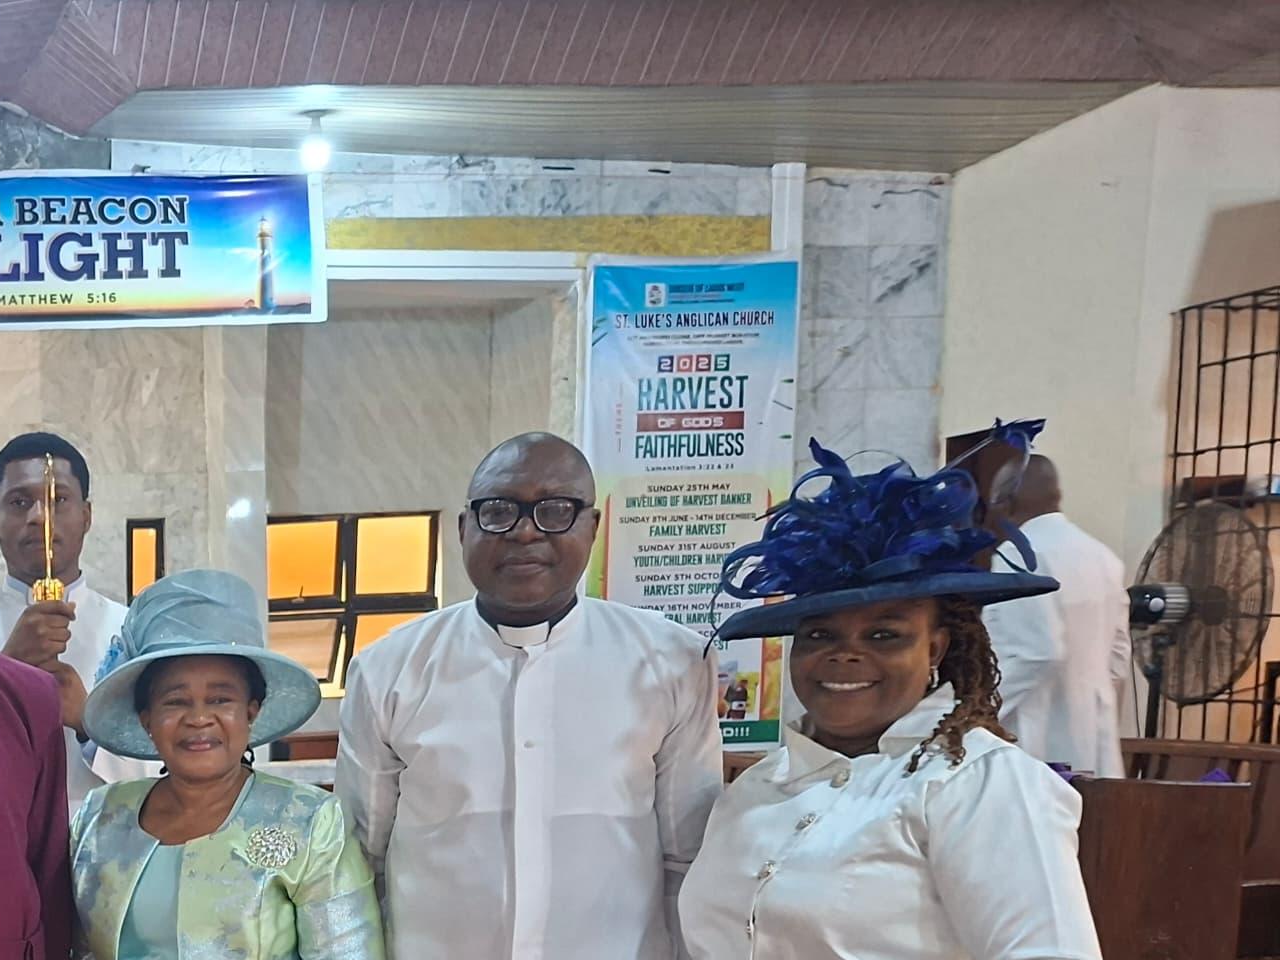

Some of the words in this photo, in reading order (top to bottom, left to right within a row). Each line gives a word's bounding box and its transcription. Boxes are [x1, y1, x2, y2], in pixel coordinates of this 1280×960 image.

[15, 197, 188, 225] BEACON
[87, 292, 116, 303] 5:16
[615, 314, 630, 329] ST.
[635, 313, 672, 329] LUKE'S
[676, 312, 728, 327] ANGLICAN
[733, 311, 774, 325] CHURCH
[659, 356, 728, 371] 2025
[637, 375, 748, 411] HARVEST
[657, 418, 675, 428] OF
[635, 432, 744, 458] FAITHFULNESS
[648, 485, 683, 493] SUNDAY
[686, 484, 709, 492] 25TH
[712, 483, 731, 491] MAY
[626, 495, 668, 508] UNVEILING
[670, 495, 680, 507] OF
[682, 494, 718, 506] HARVEST
[720, 493, 752, 505] BANNER
[619, 516, 650, 524] SUNDAY
[669, 514, 689, 522] JUNE
[696, 513, 713, 521] 14TH
[649, 525, 683, 537] FAMILY
[686, 523, 727, 535] HARVEST
[678, 543, 697, 551] 31ST
[700, 542, 736, 550] AUGUST
[633, 554, 703, 568] YOUTH/CHILDREN
[705, 554, 725, 565] HARV
[635, 574, 671, 582] SUNDAY
[674, 573, 692, 581] 5TH
[694, 572, 720, 580] OCTO
[644, 583, 685, 596] HARVEST
[691, 601, 742, 610] NOVMBER
